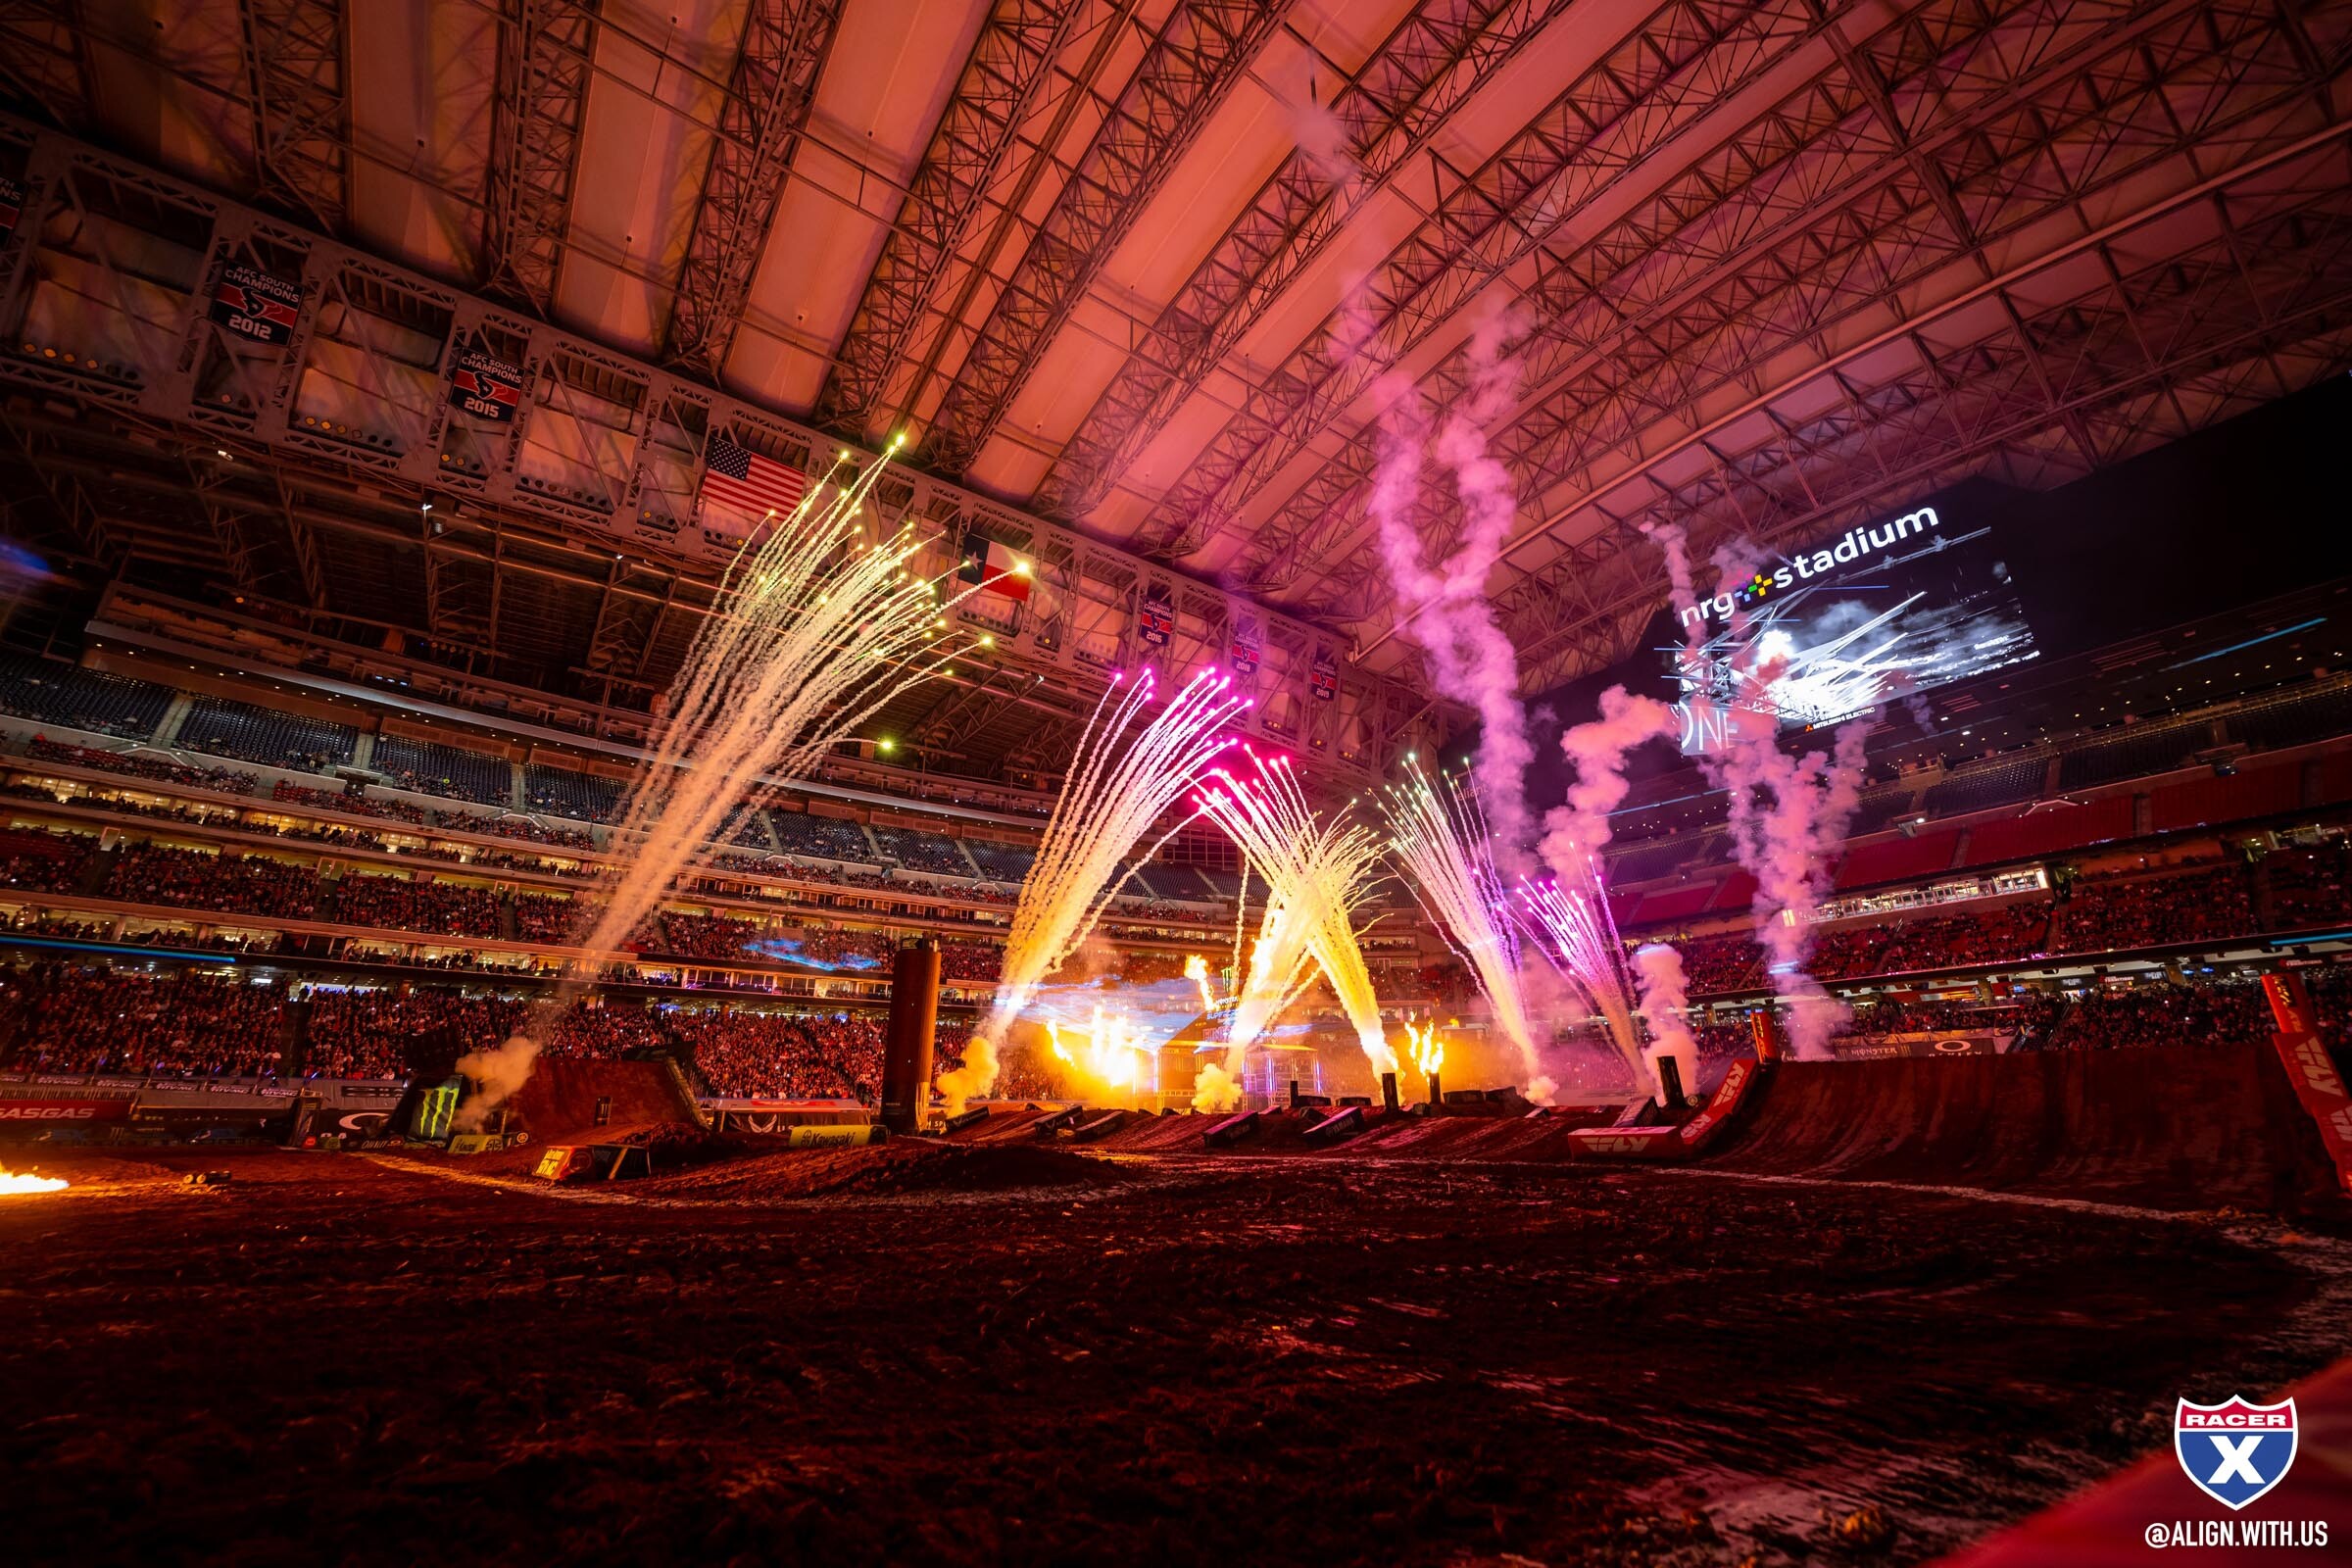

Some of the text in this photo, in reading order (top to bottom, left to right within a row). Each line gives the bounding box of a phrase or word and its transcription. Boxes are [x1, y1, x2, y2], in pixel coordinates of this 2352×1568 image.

[225, 270, 300, 303] CHAMPIONS
[236, 267, 294, 291] AFC SOUTH
[228, 314, 271, 340] 2012
[462, 357, 522, 384] CHAMPIONS
[470, 353, 517, 374] AFC SOUTH
[464, 397, 500, 418] 2015
[1681, 506, 1939, 627] nrg stadium
[1851, 1047, 1898, 1056] MONSTER
[2294, 1036, 2344, 1097] FLY
[1713, 1061, 1745, 1106] FLY
[0, 1107, 96, 1119] ASGAS
[811, 1131, 856, 1146] Kawasaki
[1580, 1136, 1652, 1152] FLY
